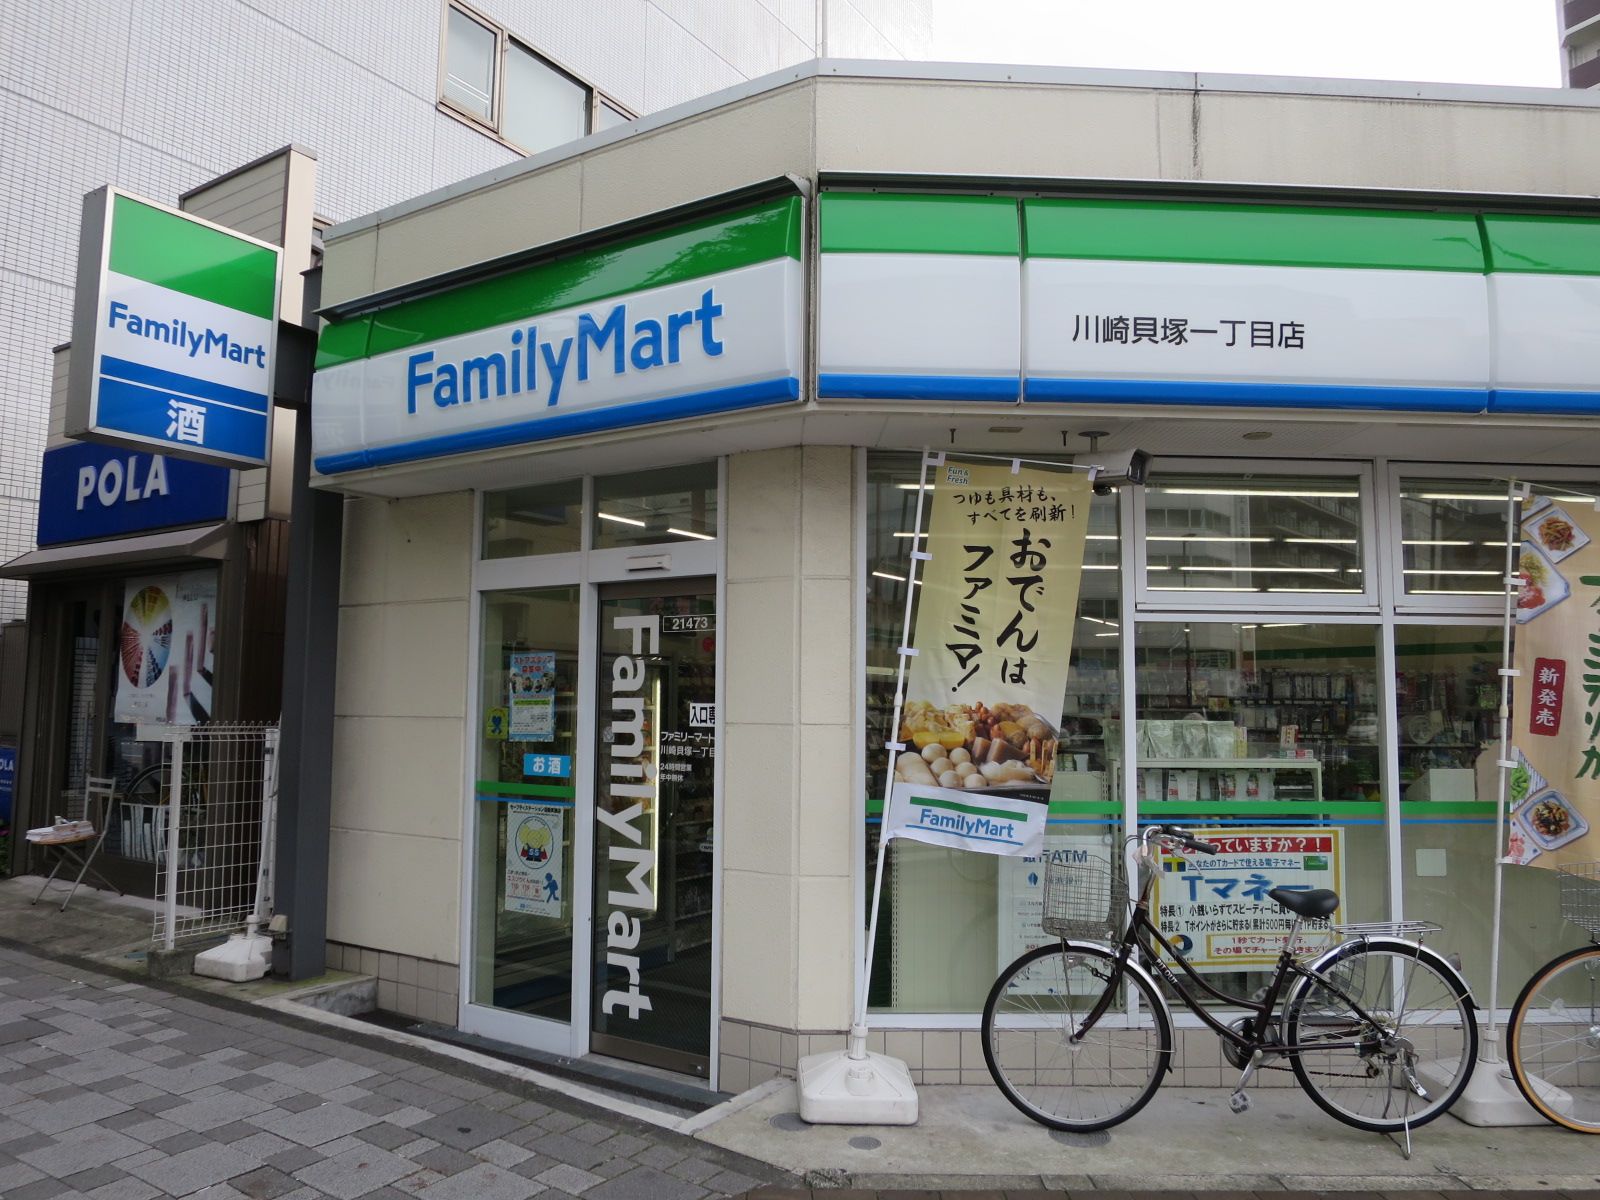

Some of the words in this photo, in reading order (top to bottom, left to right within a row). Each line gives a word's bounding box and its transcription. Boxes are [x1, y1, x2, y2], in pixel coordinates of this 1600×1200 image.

[108, 301, 267, 369] FamilyMart
[407, 287, 724, 414] FamilyMart
[1072, 314, 1305, 350] 川崎貝塚一丁目店
[165, 399, 207, 445] 酒
[76, 454, 170, 511] POLA
[947, 475, 969, 485] Fresh
[953, 485, 1056, 505] つゆも具材も、
[967, 504, 1076, 525] すべてを刷新！
[672, 617, 708, 630] 21473
[945, 545, 994, 693] ファミマ！
[996, 527, 1052, 686] おでんは
[1535, 666, 1561, 728] 新発売
[533, 756, 561, 774] お酒
[597, 614, 661, 1020] FamilyMart
[920, 808, 1014, 839] FamilyMart
